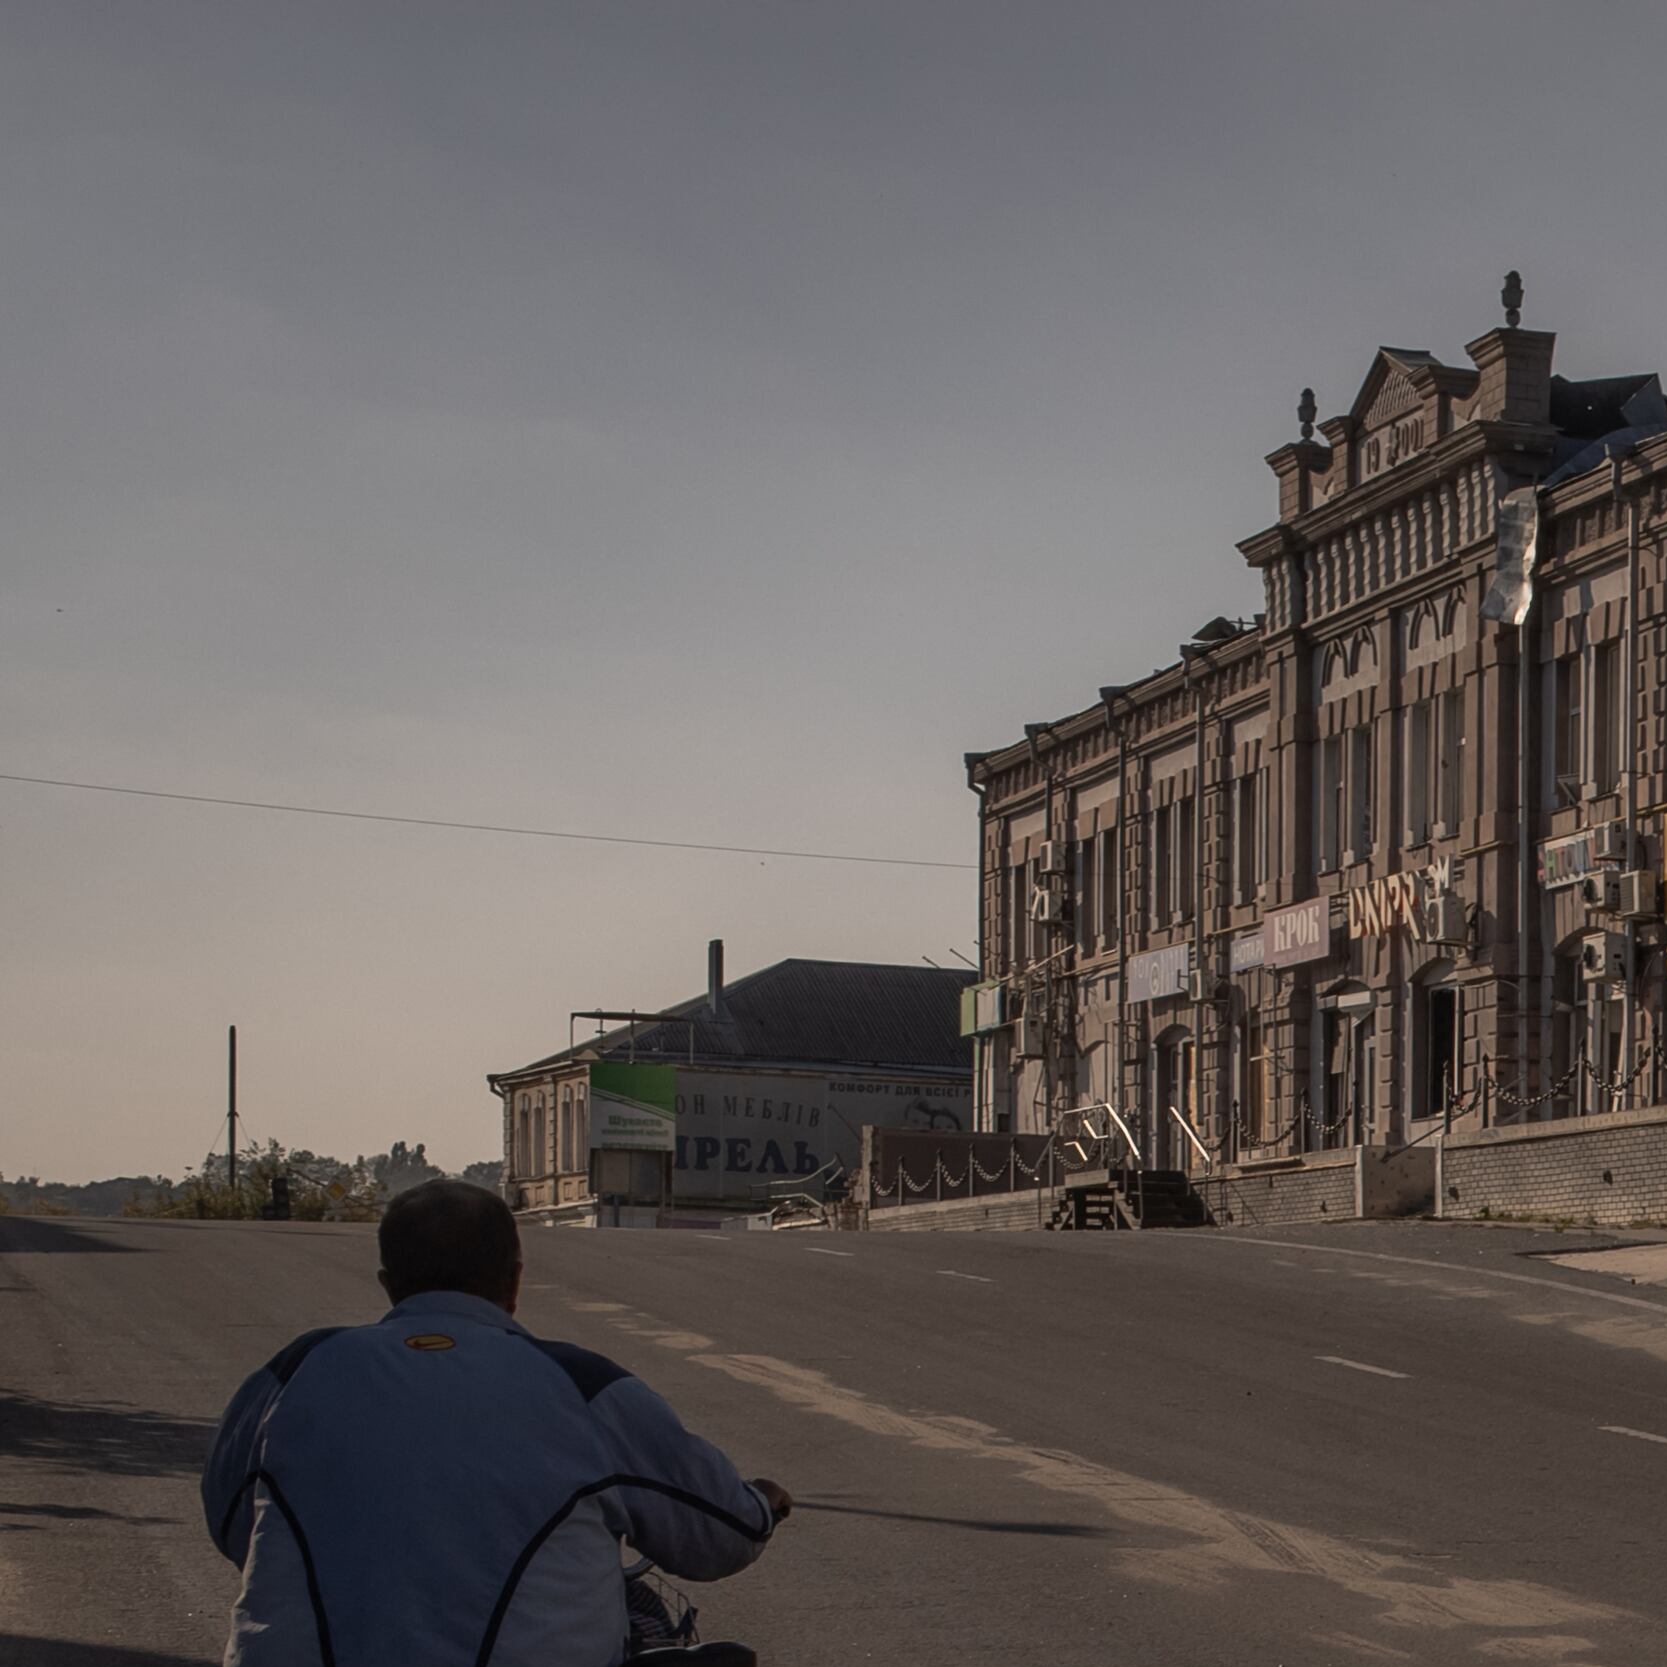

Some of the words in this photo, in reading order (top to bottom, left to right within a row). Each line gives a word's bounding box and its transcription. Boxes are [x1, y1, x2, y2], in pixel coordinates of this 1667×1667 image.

[1273, 904, 1321, 954] КРОК
[829, 1082, 891, 1095] КОМФОРТ
[895, 1086, 921, 1096] ДЛЯ
[675, 1093, 705, 1116] ОН
[723, 1095, 821, 1128] МЕБЛІВ
[675, 1135, 820, 1175] РЕЛЬ
